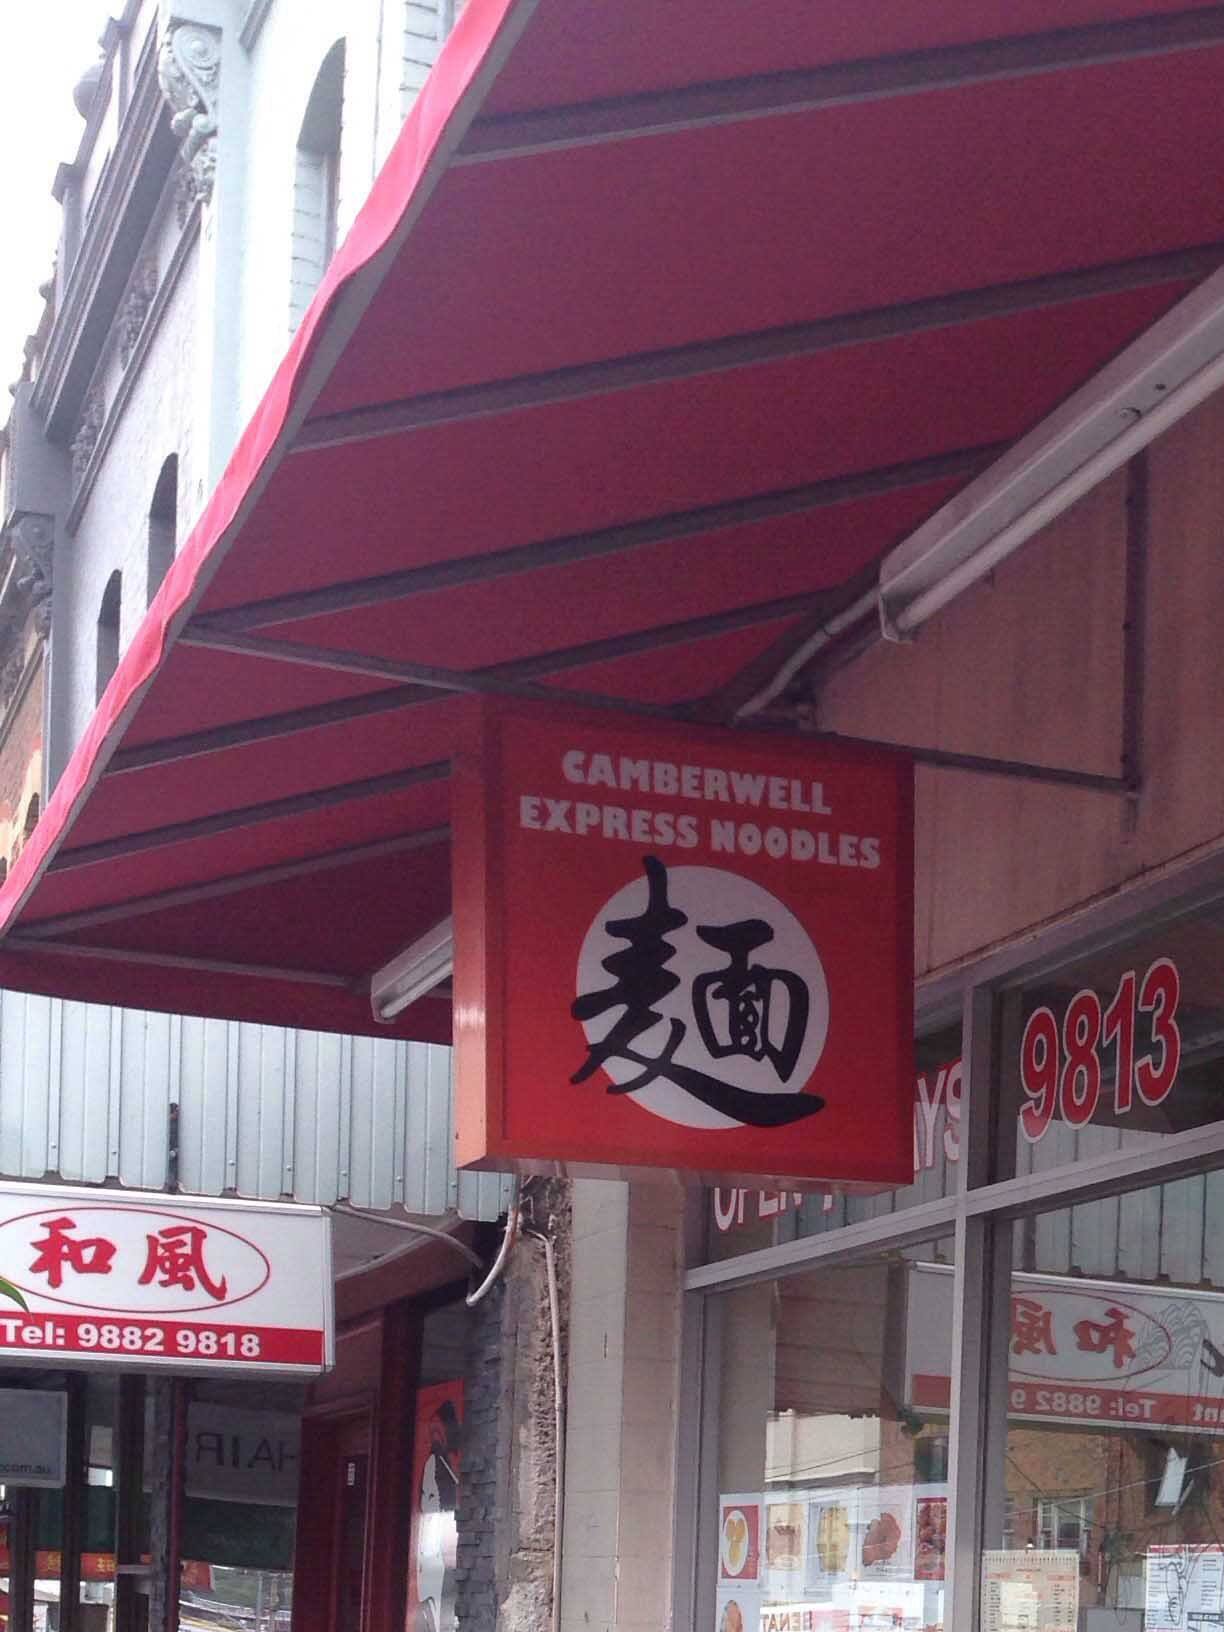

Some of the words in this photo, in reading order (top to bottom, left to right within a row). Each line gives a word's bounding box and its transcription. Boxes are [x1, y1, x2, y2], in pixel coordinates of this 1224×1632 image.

[562, 749, 832, 816] CAMBERWELL
[519, 794, 699, 849] EXPRESS
[710, 818, 881, 870] NOODLES
[1019, 957, 1182, 1144] 9813
[29, 1216, 228, 1302] 和風
[1, 1318, 66, 1346] Tel:
[76, 1322, 165, 1352] 9882
[175, 1329, 261, 1357] 9818
